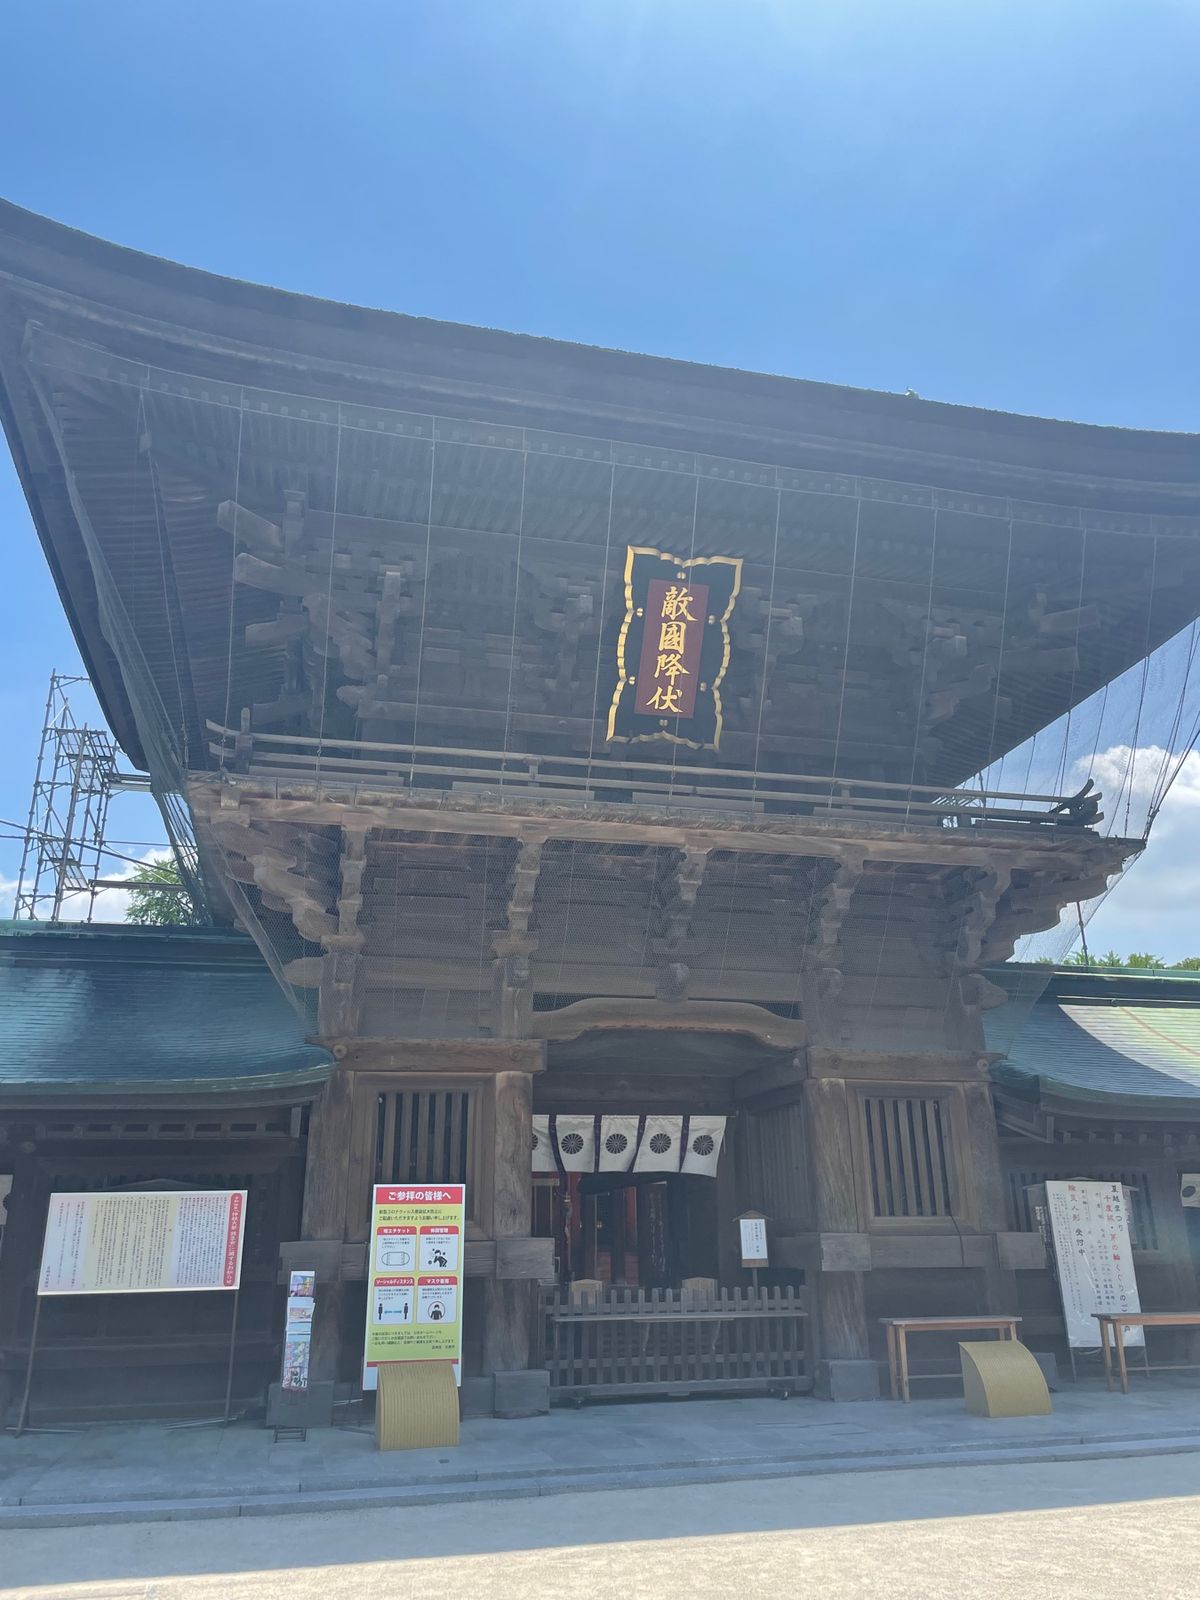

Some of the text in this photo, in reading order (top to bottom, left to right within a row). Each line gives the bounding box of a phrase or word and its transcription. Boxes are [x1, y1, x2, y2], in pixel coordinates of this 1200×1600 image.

[645, 585, 698, 713] 敵國降伏
[388, 1190, 452, 1201] ご参拝の皆様へ
